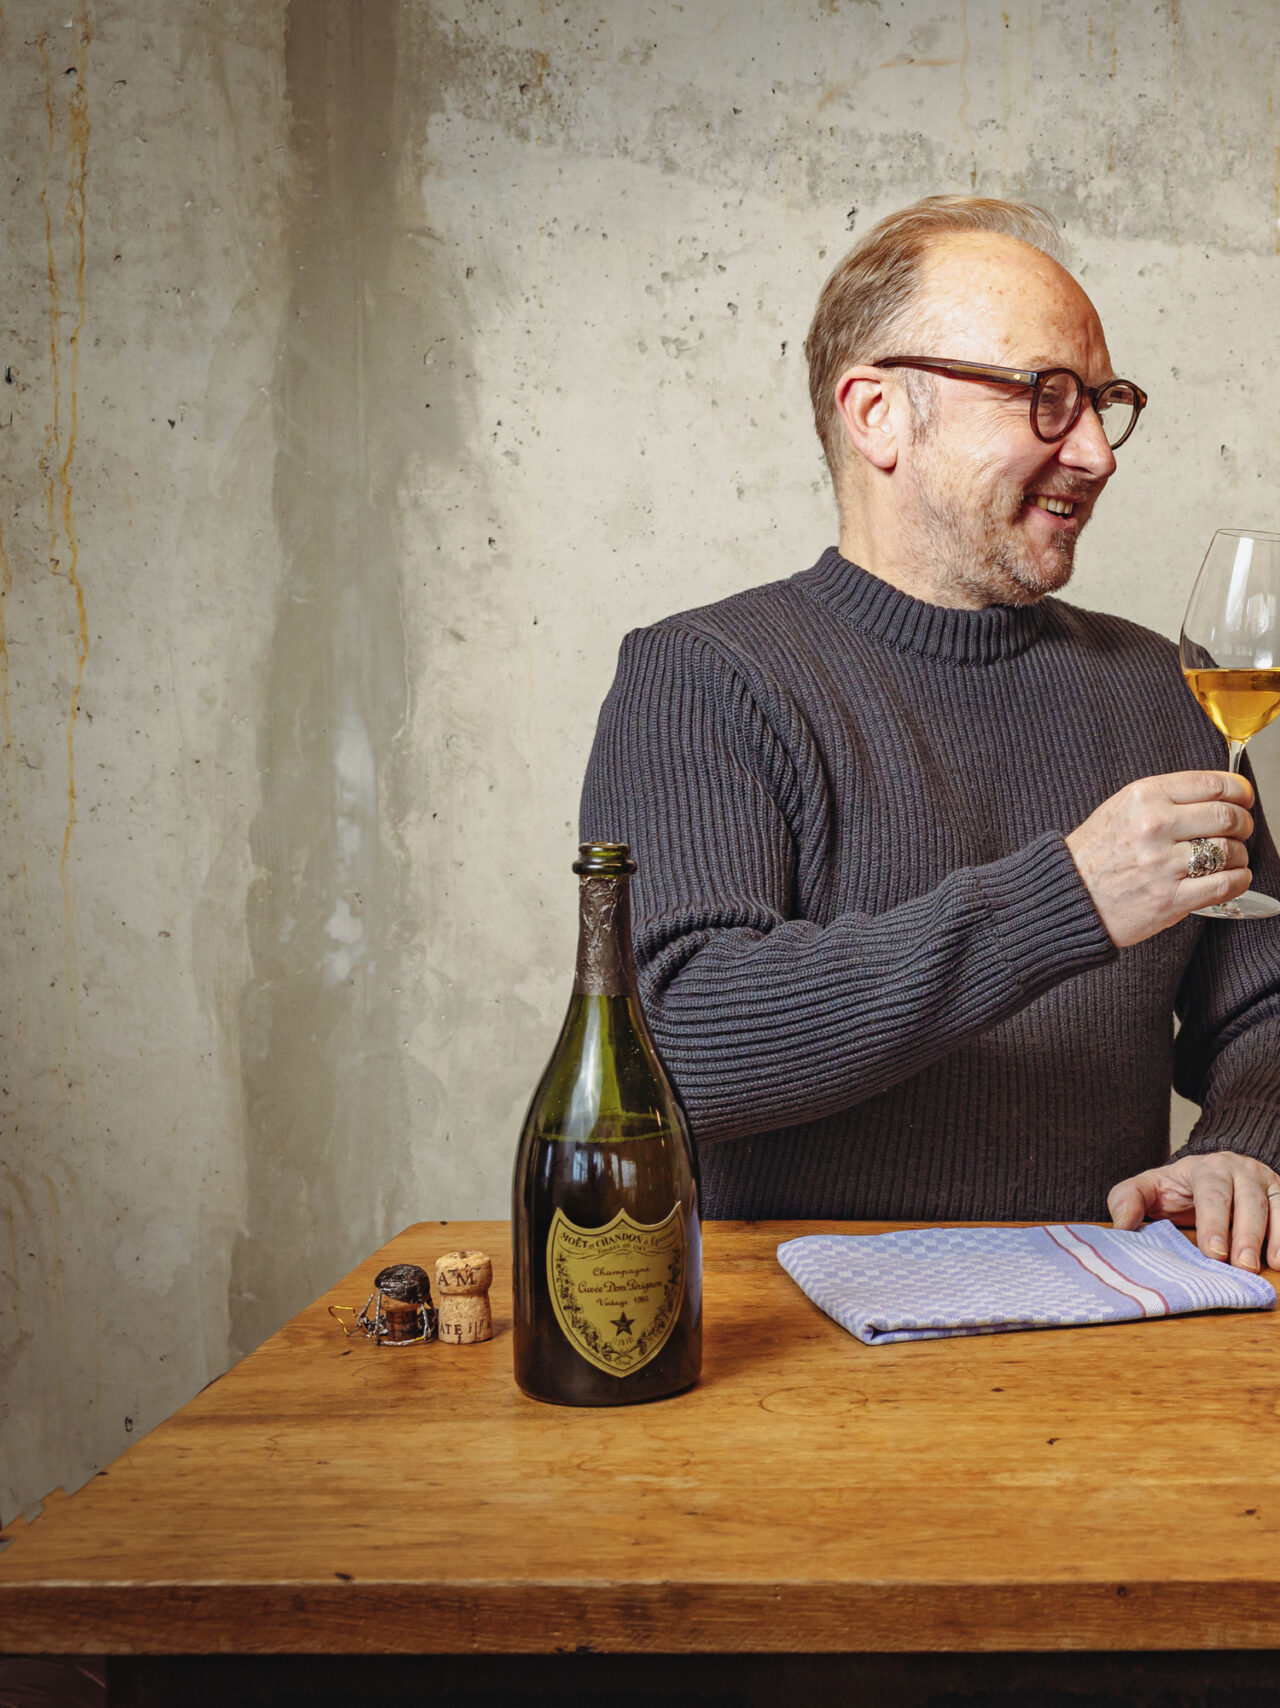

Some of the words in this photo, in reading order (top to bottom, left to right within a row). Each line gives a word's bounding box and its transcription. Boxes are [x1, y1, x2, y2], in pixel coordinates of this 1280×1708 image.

[595, 1233, 642, 1248] CHANDON
[592, 1266, 651, 1278] Champagne
[604, 1280, 626, 1292] Dom
